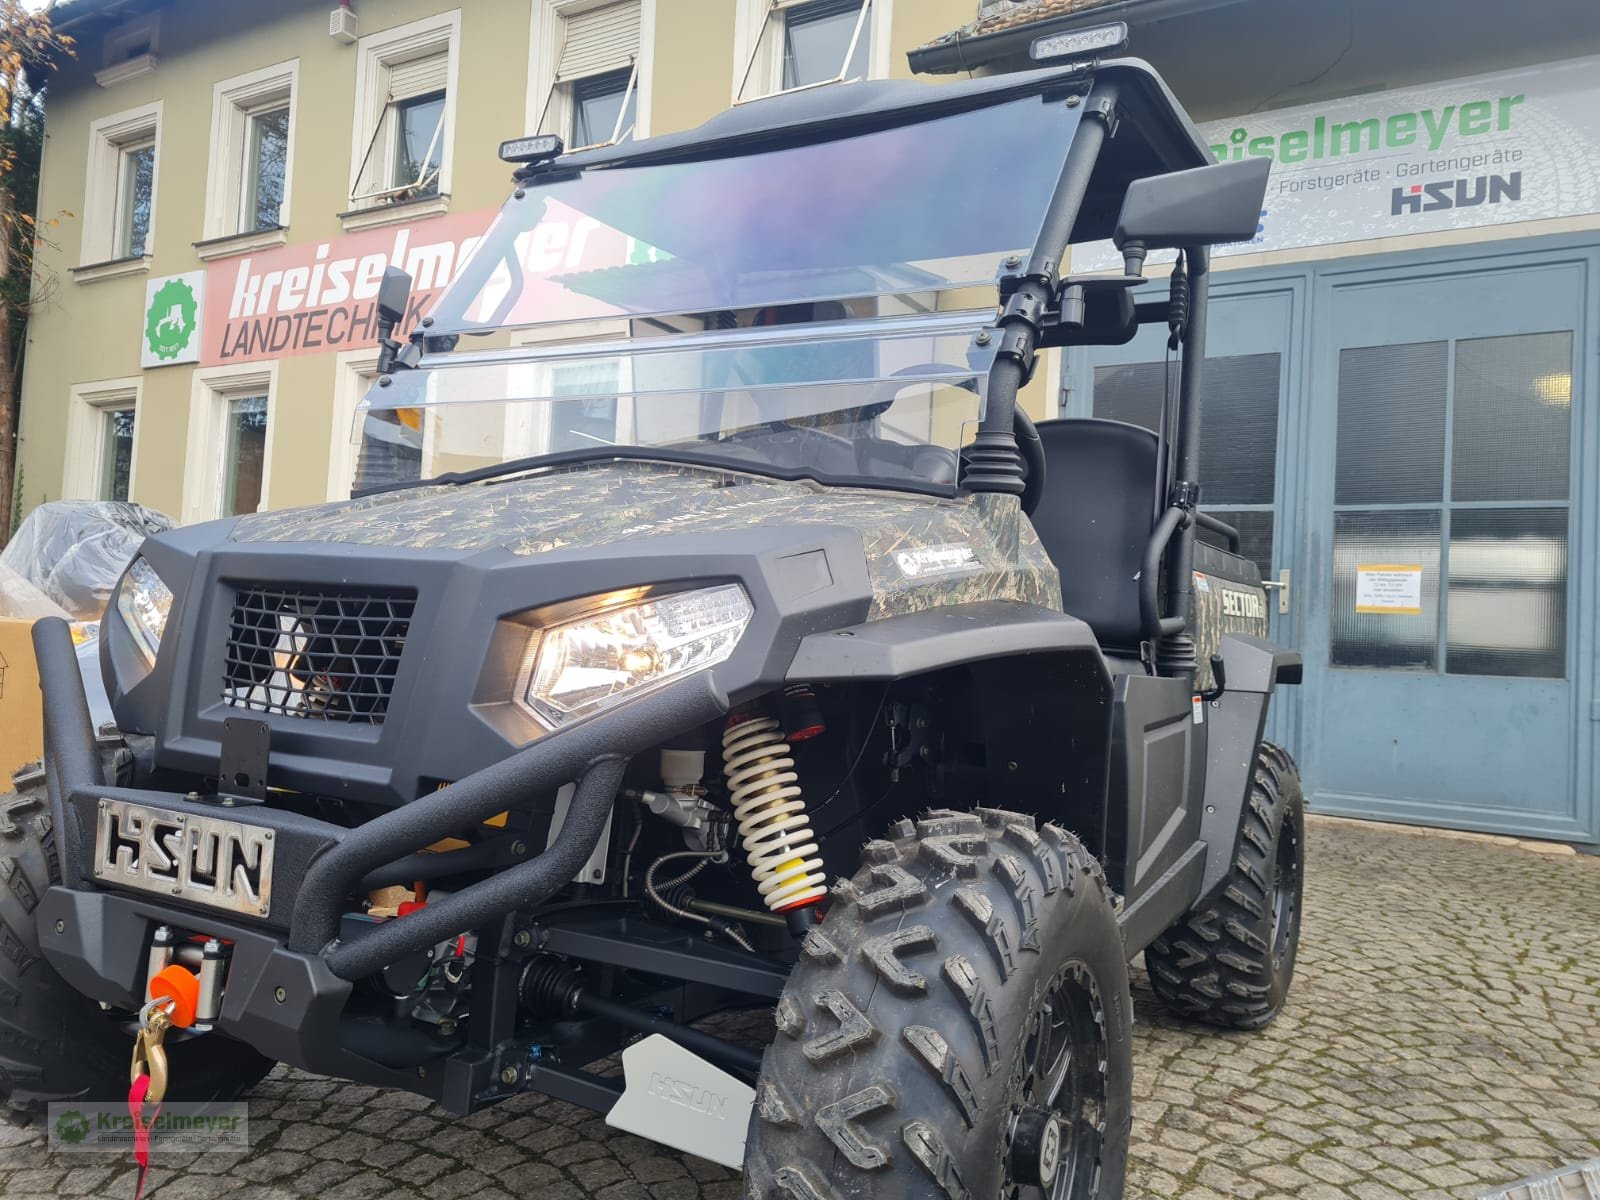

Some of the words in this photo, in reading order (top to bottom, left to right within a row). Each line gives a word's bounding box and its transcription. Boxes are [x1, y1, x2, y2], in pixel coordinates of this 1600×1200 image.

[1279, 168, 1381, 195] Forstgeräte
[1395, 148, 1523, 180] Gartengeräte
[1222, 589, 1259, 618] SECTOR
